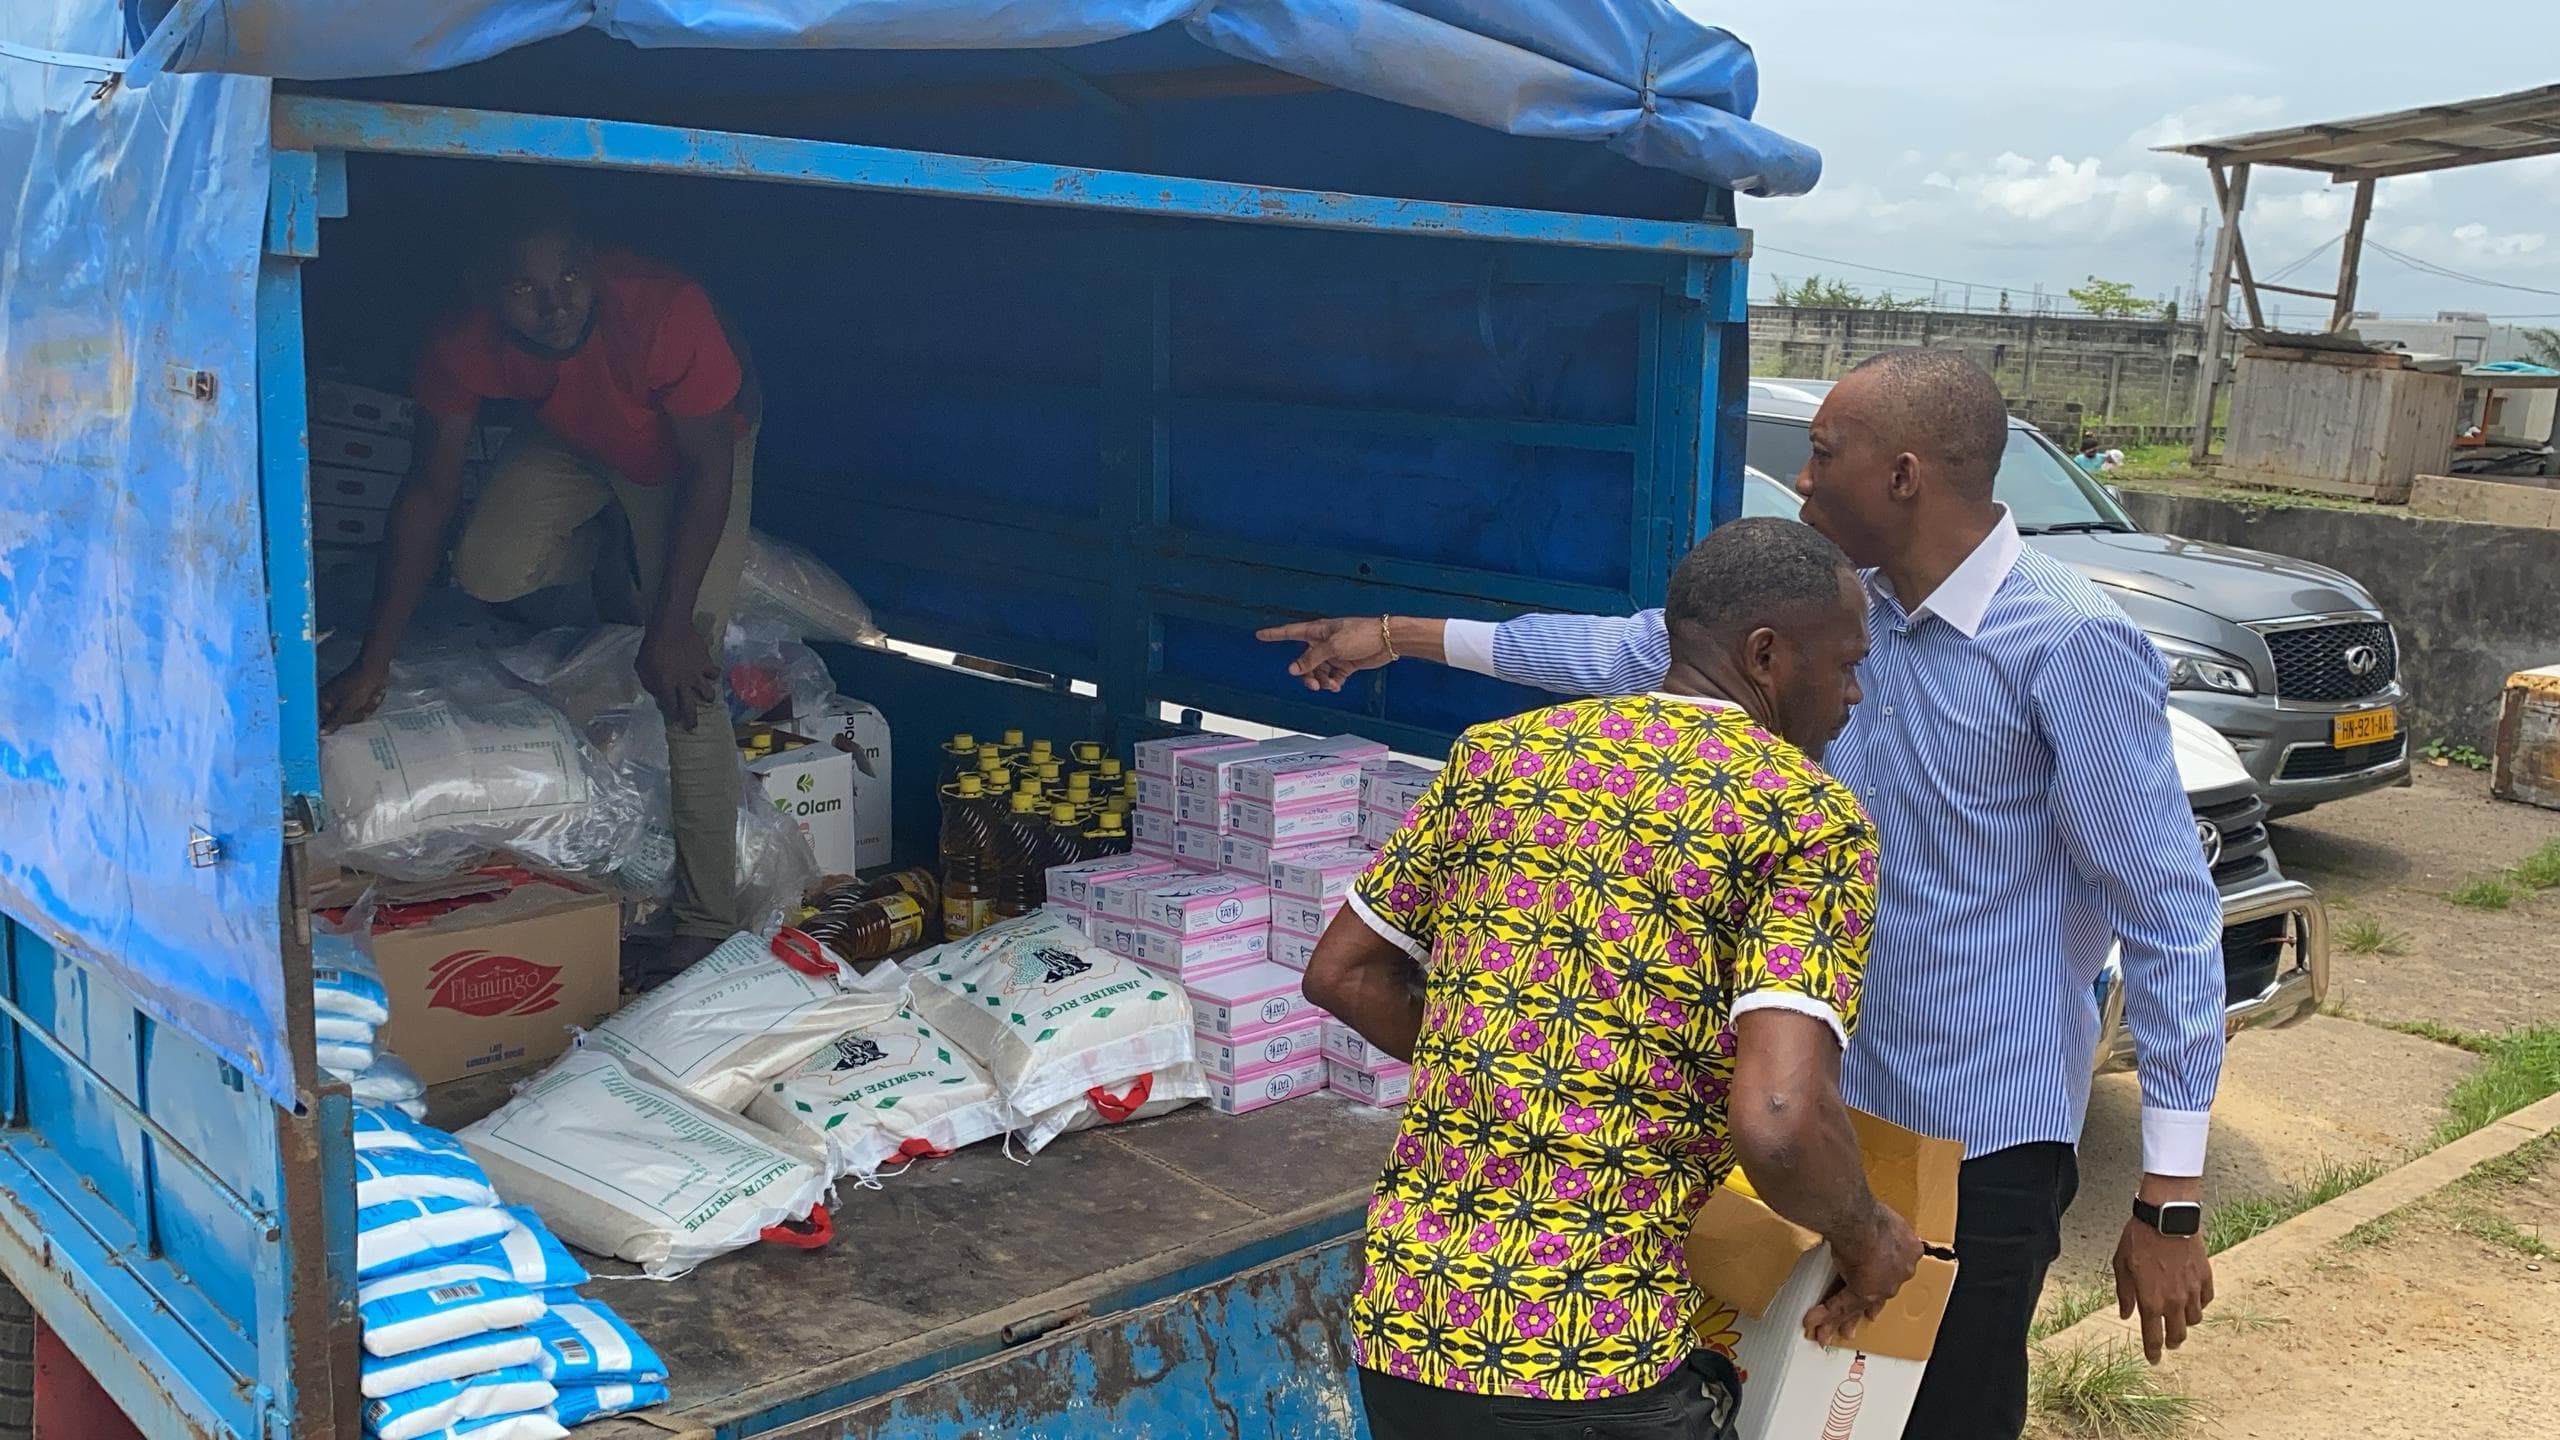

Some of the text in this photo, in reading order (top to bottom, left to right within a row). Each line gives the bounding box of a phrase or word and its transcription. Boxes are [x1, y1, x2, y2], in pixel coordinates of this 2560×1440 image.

[796, 798, 842, 816] Olam
[450, 968, 541, 1003] Flamingo
[1041, 979, 1141, 1020] JASMINE RICE
[828, 1070, 936, 1107] JASMINE RC
[743, 1161, 798, 1197] VALEUR
